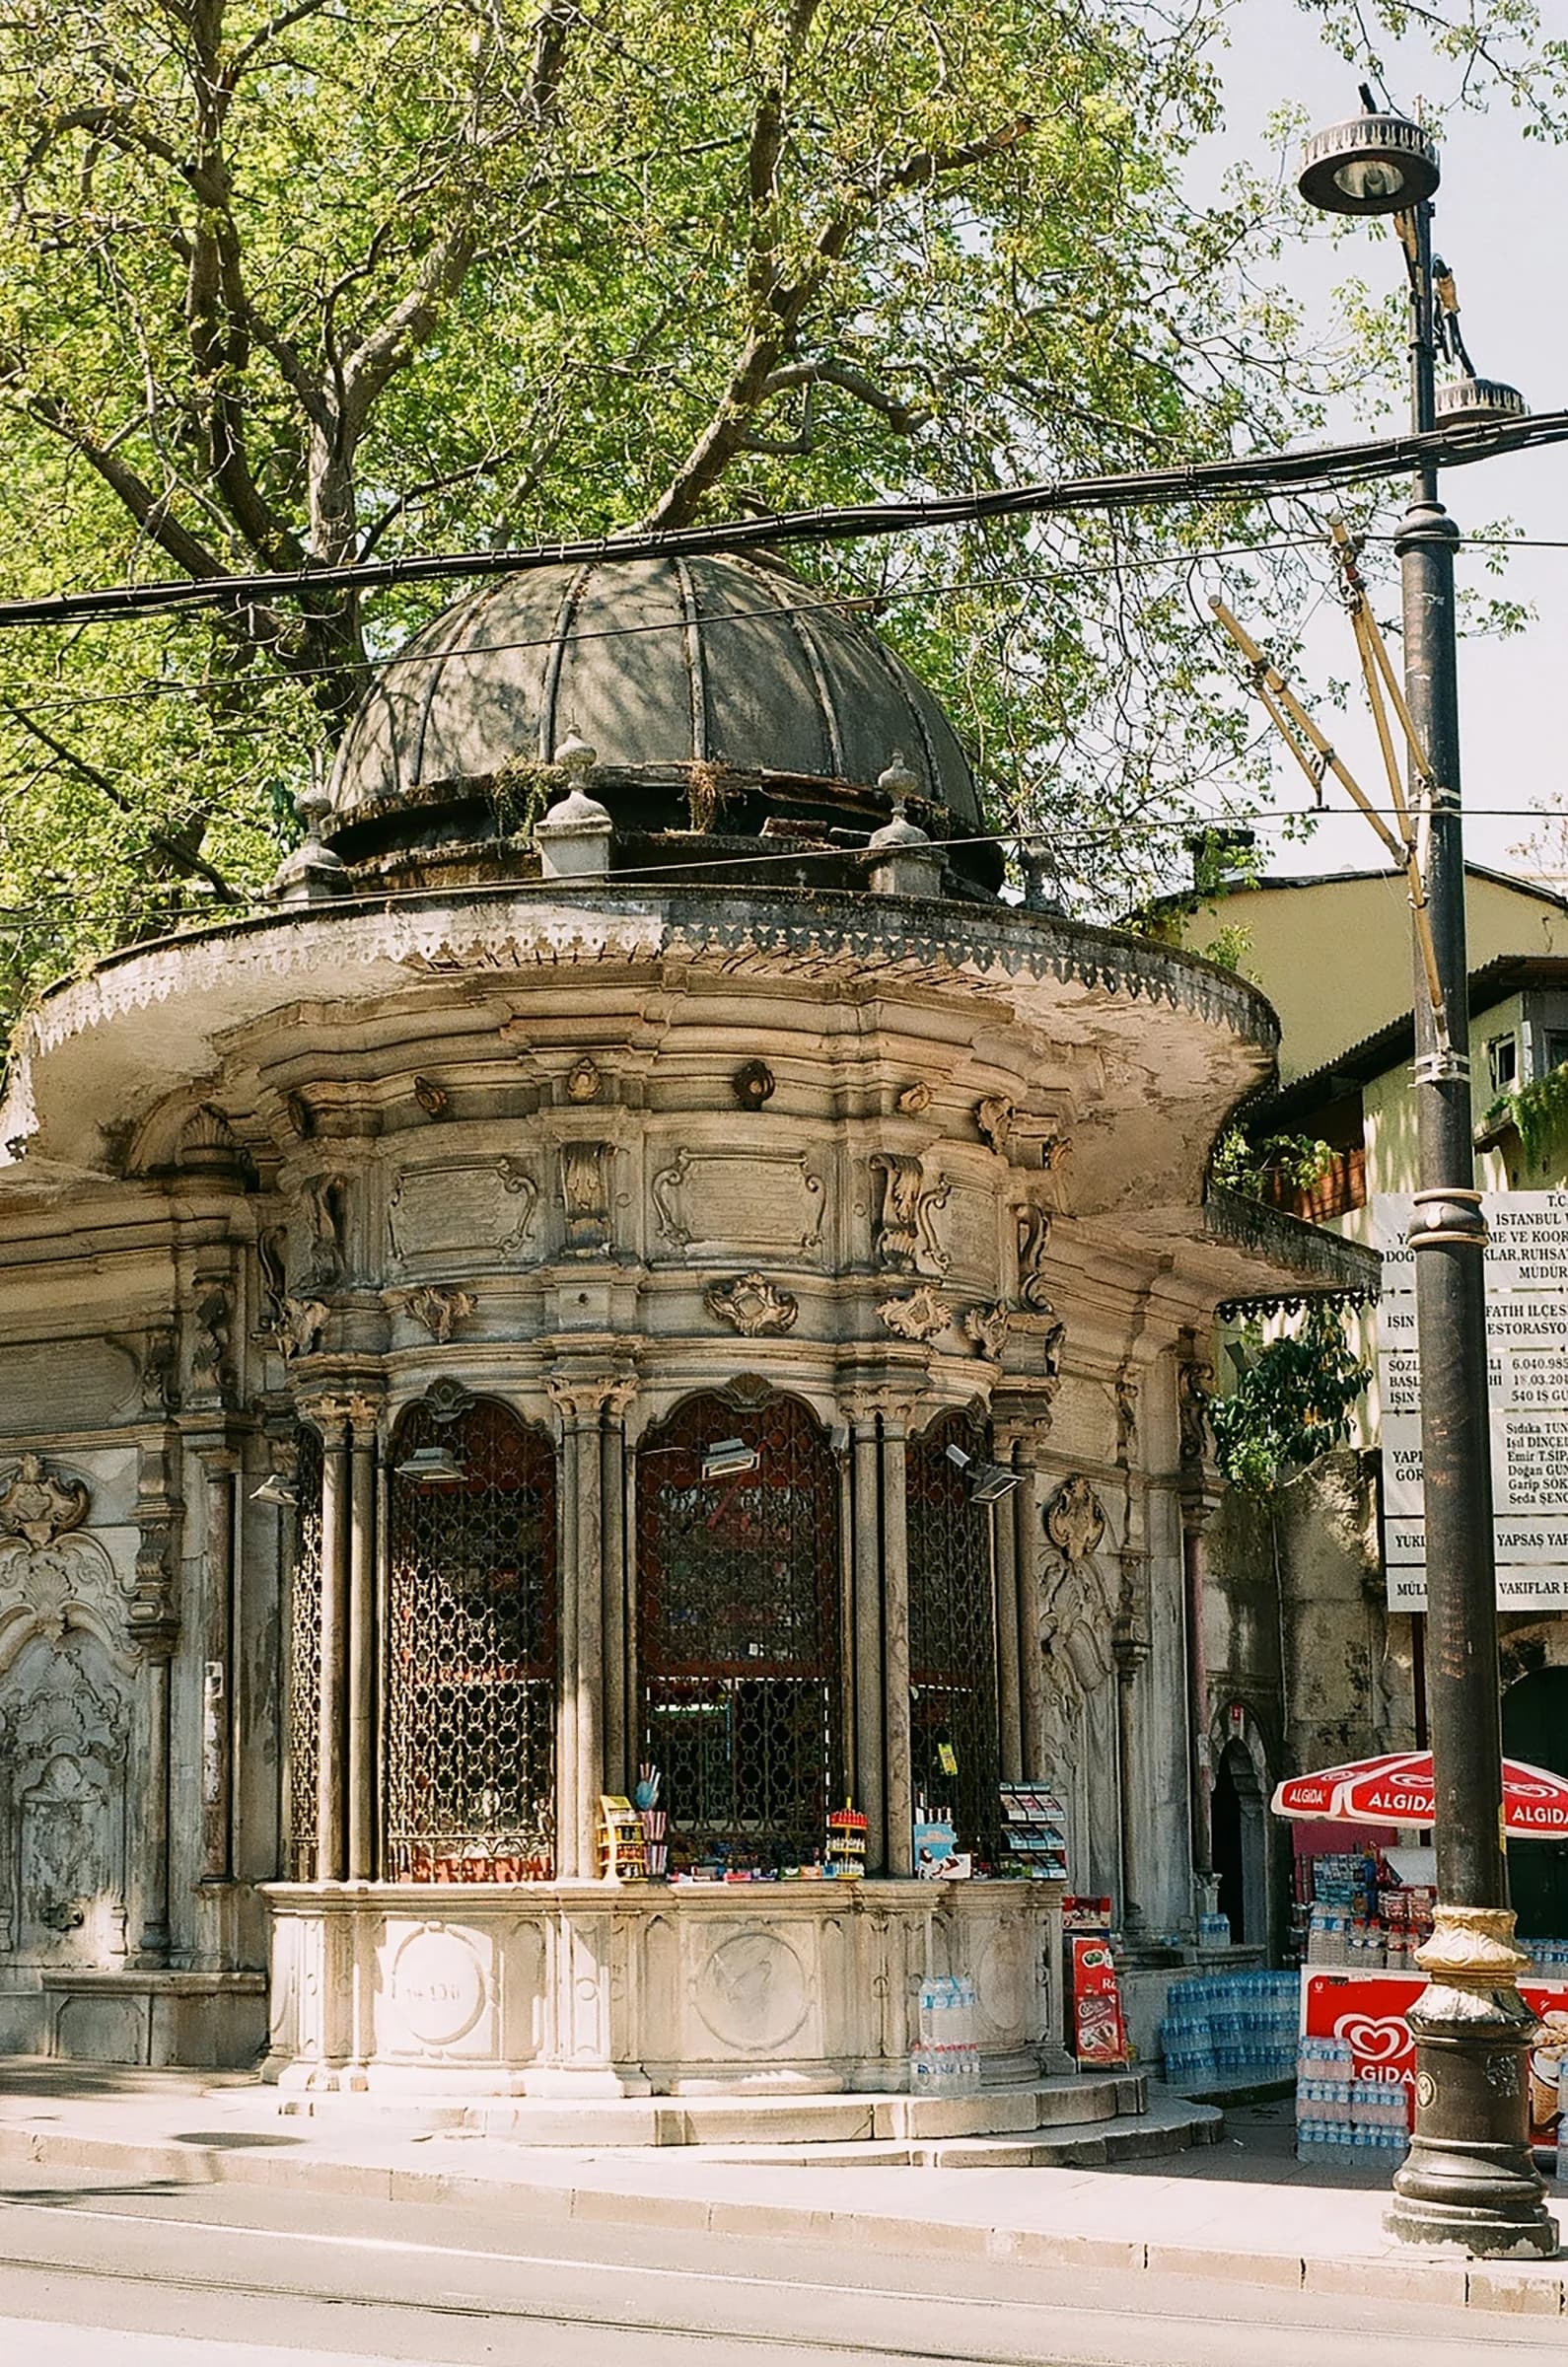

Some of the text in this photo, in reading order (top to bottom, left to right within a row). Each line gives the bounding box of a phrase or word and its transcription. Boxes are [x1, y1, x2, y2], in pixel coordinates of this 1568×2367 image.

[1396, 1232, 1408, 1245] Y
[1510, 1231, 1528, 1243] VE
[1487, 1322, 1568, 1334] ESTORASYO
[1511, 1390, 1533, 1401] 540
[1507, 1450, 1534, 1462] Emir
[1508, 1478, 1539, 1492] Garip
[1509, 1492, 1536, 1505] Seda
[1497, 1534, 1544, 1549] YAPSAŞ
[1499, 1582, 1560, 1595] VAKIFLAR
